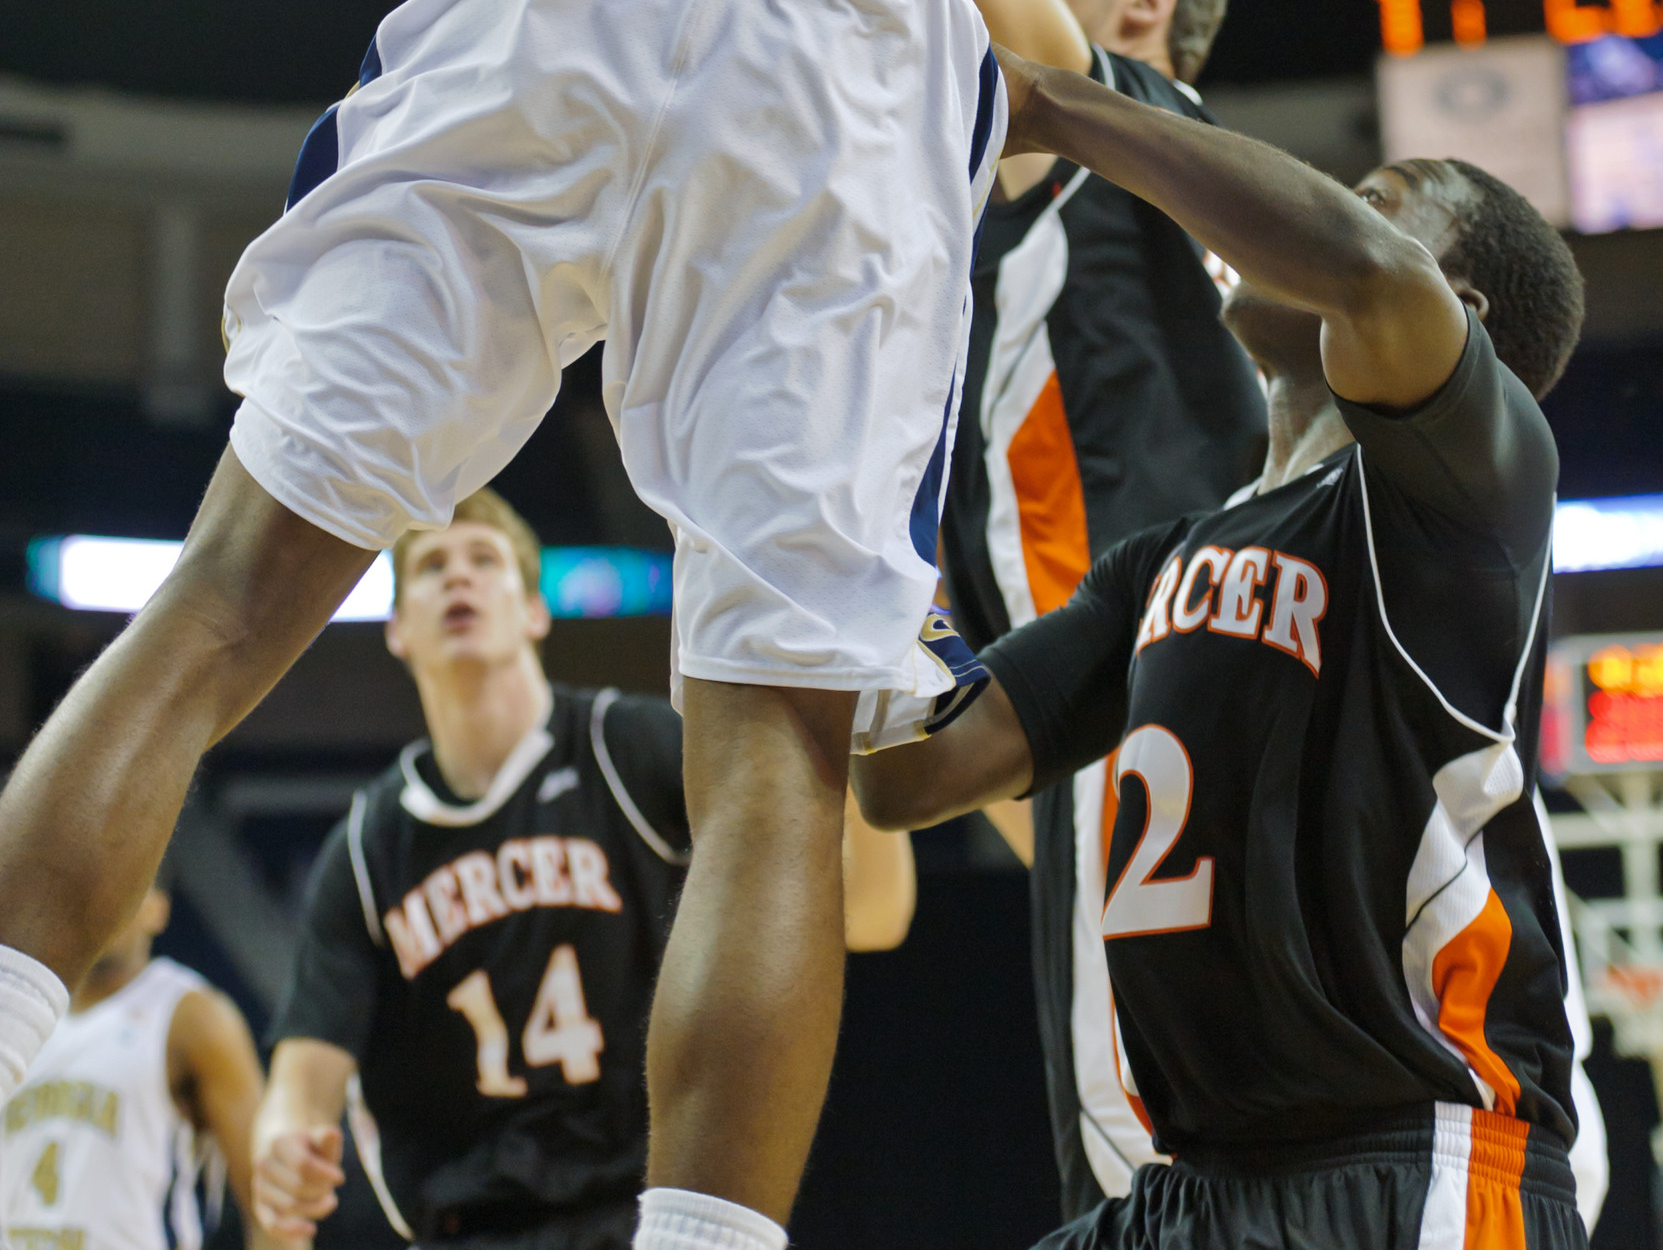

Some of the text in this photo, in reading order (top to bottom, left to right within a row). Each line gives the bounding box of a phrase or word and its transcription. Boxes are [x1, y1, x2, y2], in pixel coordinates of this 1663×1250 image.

[1136, 545, 1329, 679] RCER
[1101, 723, 1215, 940] 2
[383, 836, 623, 980] MERCER
[446, 944, 605, 1098] 14
